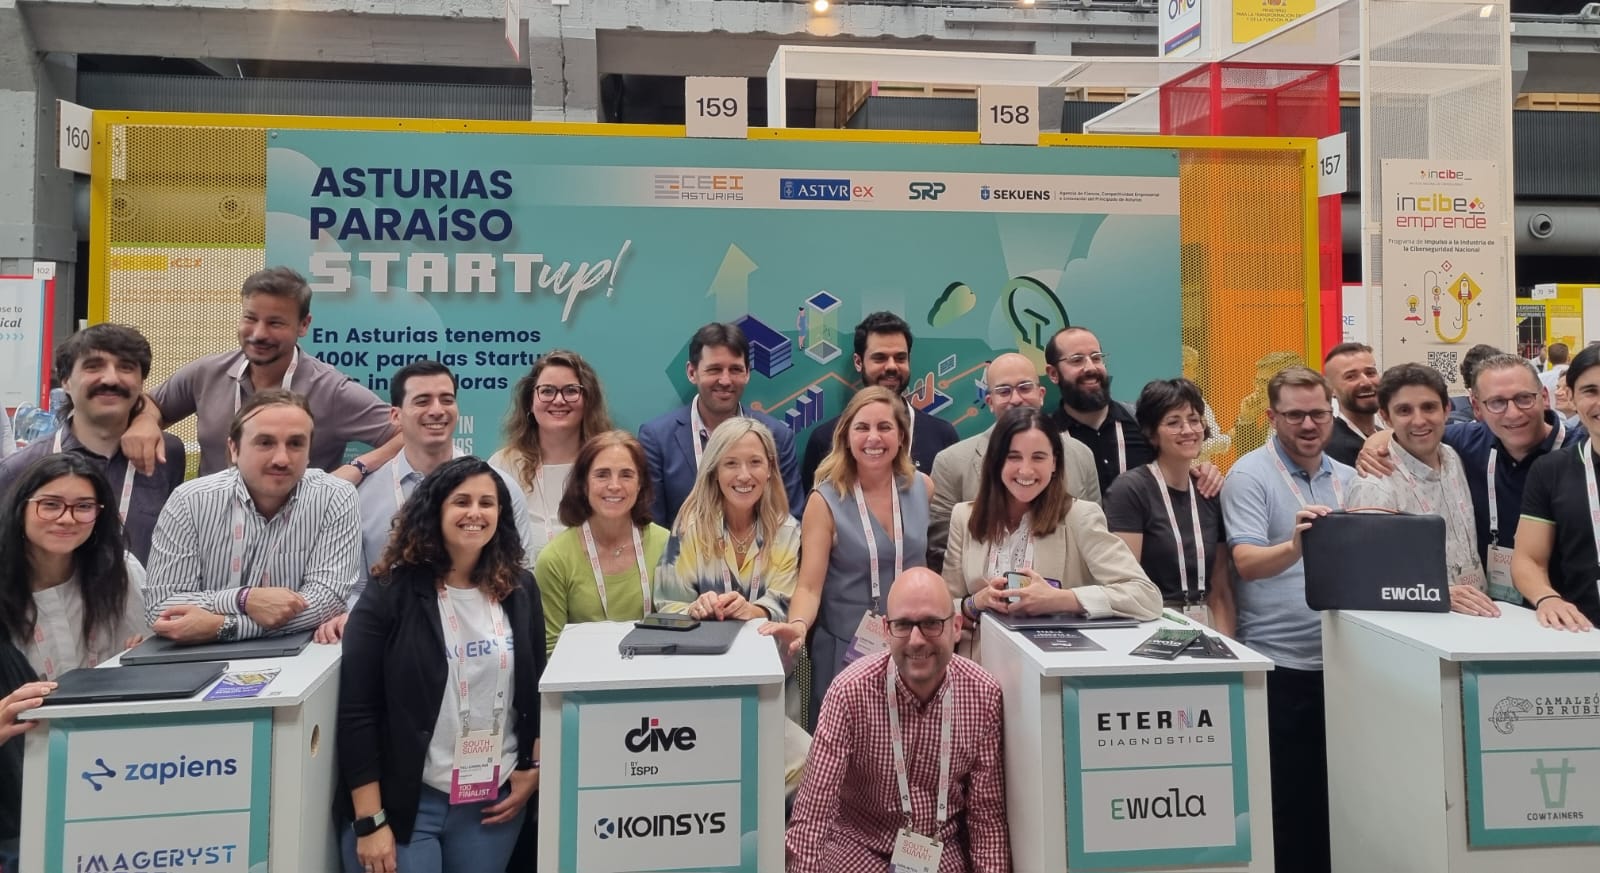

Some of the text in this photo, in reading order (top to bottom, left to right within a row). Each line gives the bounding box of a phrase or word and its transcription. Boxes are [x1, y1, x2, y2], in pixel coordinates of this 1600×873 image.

[696, 97, 738, 117] 159
[990, 105, 1030, 124] 158
[66, 125, 90, 150] 160
[1320, 154, 1341, 176] 157
[311, 167, 513, 199] ASTURIAS
[681, 175, 744, 190] CEEI
[681, 192, 744, 201] ASTURIAS
[908, 182, 946, 200] SRP
[993, 190, 1051, 200] SEKUENS
[1396, 215, 1487, 232] emprende
[1388, 239, 1415, 247] Programa
[37, 267, 50, 275] 102
[0, 317, 22, 328] ical
[313, 327, 541, 343] En Asturias tenemos
[314, 351, 368, 366] 400K
[436, 350, 468, 366] las
[475, 351, 544, 366] Startu
[459, 415, 474, 434] IN
[1535, 692, 1600, 705] CAMALEÓ
[1097, 706, 1213, 731] ETERNA
[1536, 706, 1554, 716] DE
[625, 717, 697, 753] dive
[1098, 735, 1216, 748] DIAGNOSTICS
[463, 739, 490, 748] SOUTH
[124, 755, 238, 785] zapiens
[630, 766, 659, 776] ISPD
[458, 788, 490, 799] FINALIST
[1527, 811, 1584, 821] COWTAINERS
[617, 812, 726, 839] KOINSYS
